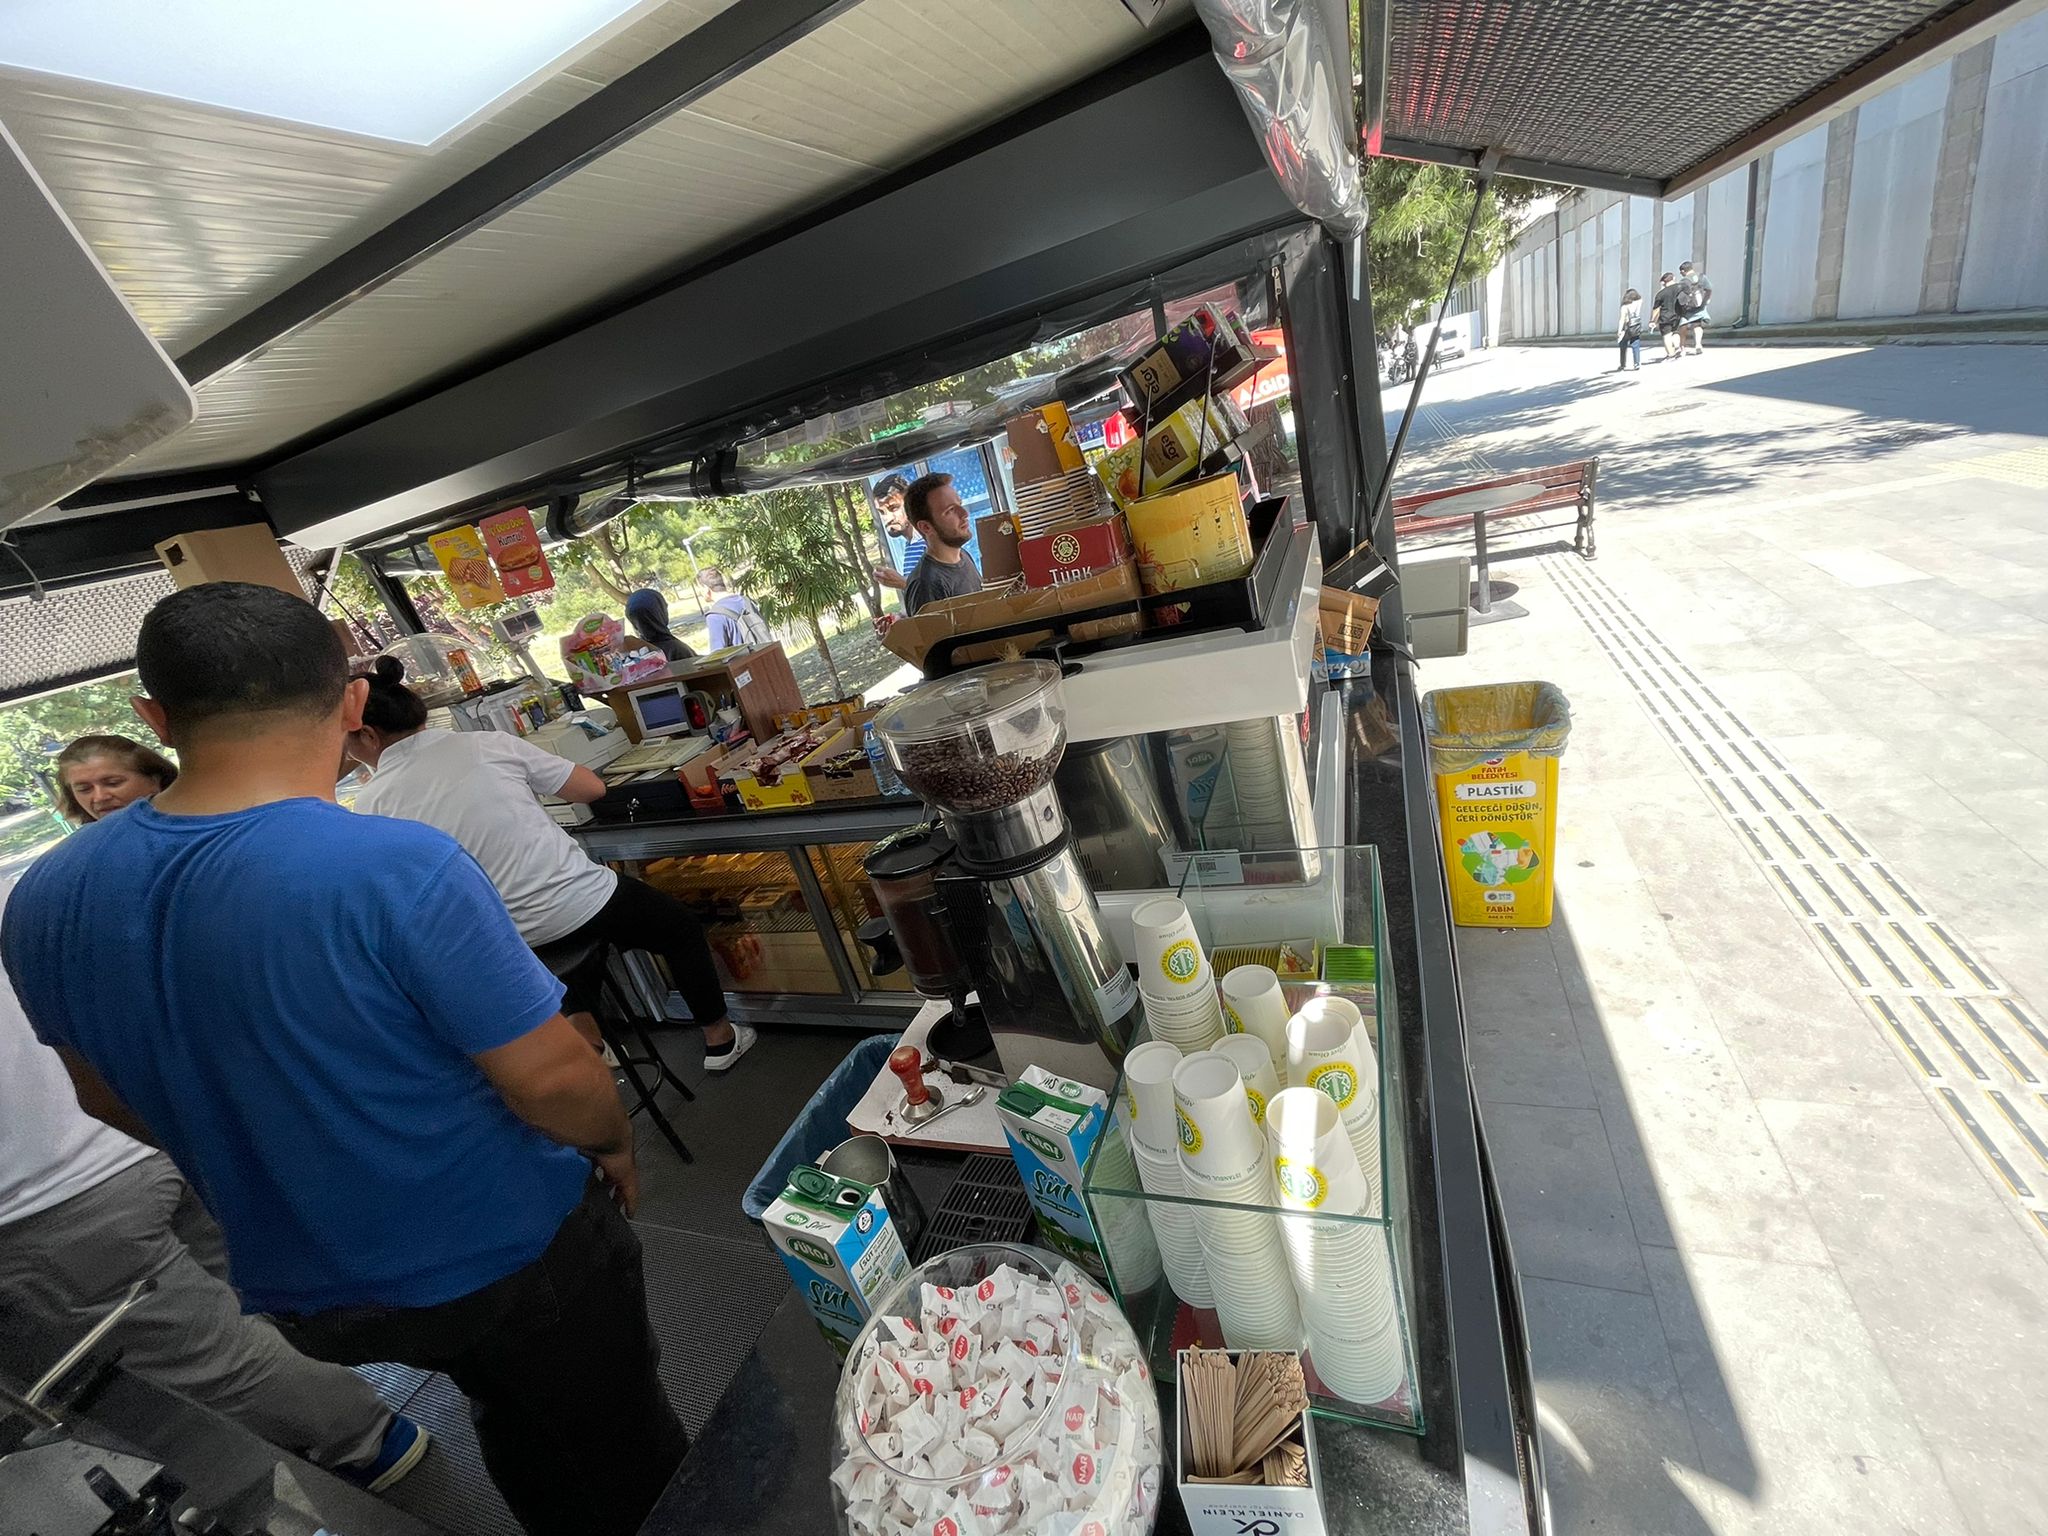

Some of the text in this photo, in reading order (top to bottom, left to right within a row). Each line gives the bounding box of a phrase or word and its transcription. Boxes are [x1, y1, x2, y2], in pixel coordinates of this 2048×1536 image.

[1140, 366, 1160, 394] efor
[1161, 433, 1180, 460] efor
[1049, 566, 1093, 585] TÜRK
[1471, 772, 1518, 780] BELEDİYESİ
[1467, 784, 1524, 796] PLASTİK
[1456, 814, 1478, 822] GERİ
[1032, 1169, 1073, 1203] Süt
[808, 1280, 852, 1311] Süt
[956, 1337, 966, 1360] NAR
[1066, 1412, 1083, 1422] NAR
[1078, 1456, 1088, 1483] NAR
[1248, 1510, 1304, 1518] DANIEL
